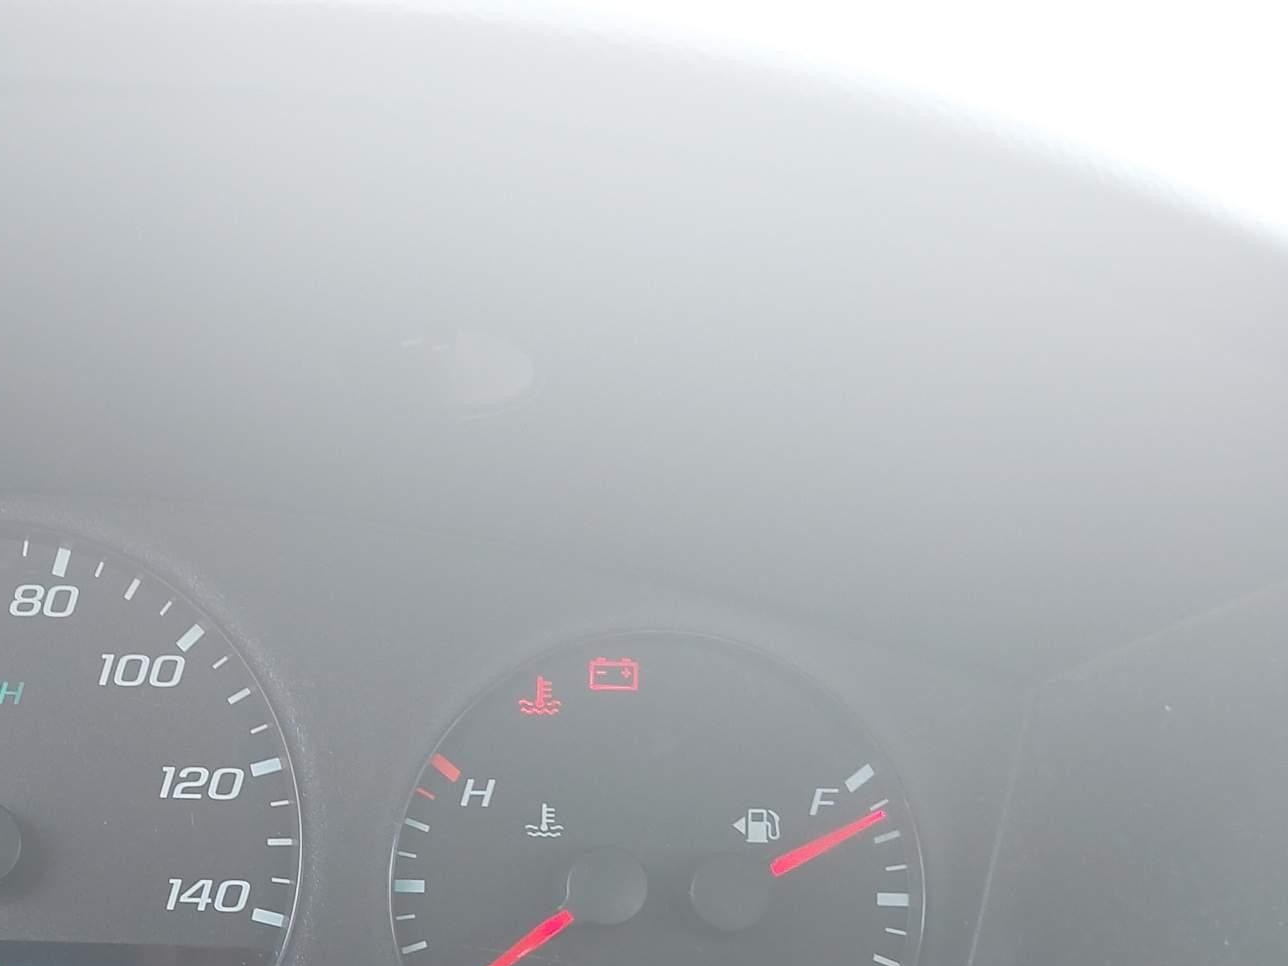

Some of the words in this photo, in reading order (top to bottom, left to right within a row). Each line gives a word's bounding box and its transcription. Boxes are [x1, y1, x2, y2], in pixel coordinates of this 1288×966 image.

[10, 584, 80, 617] 80
[98, 653, 185, 687] 100
[159, 766, 245, 800] 120
[460, 779, 496, 807] H
[810, 788, 840, 815] F
[166, 878, 251, 912] 140
